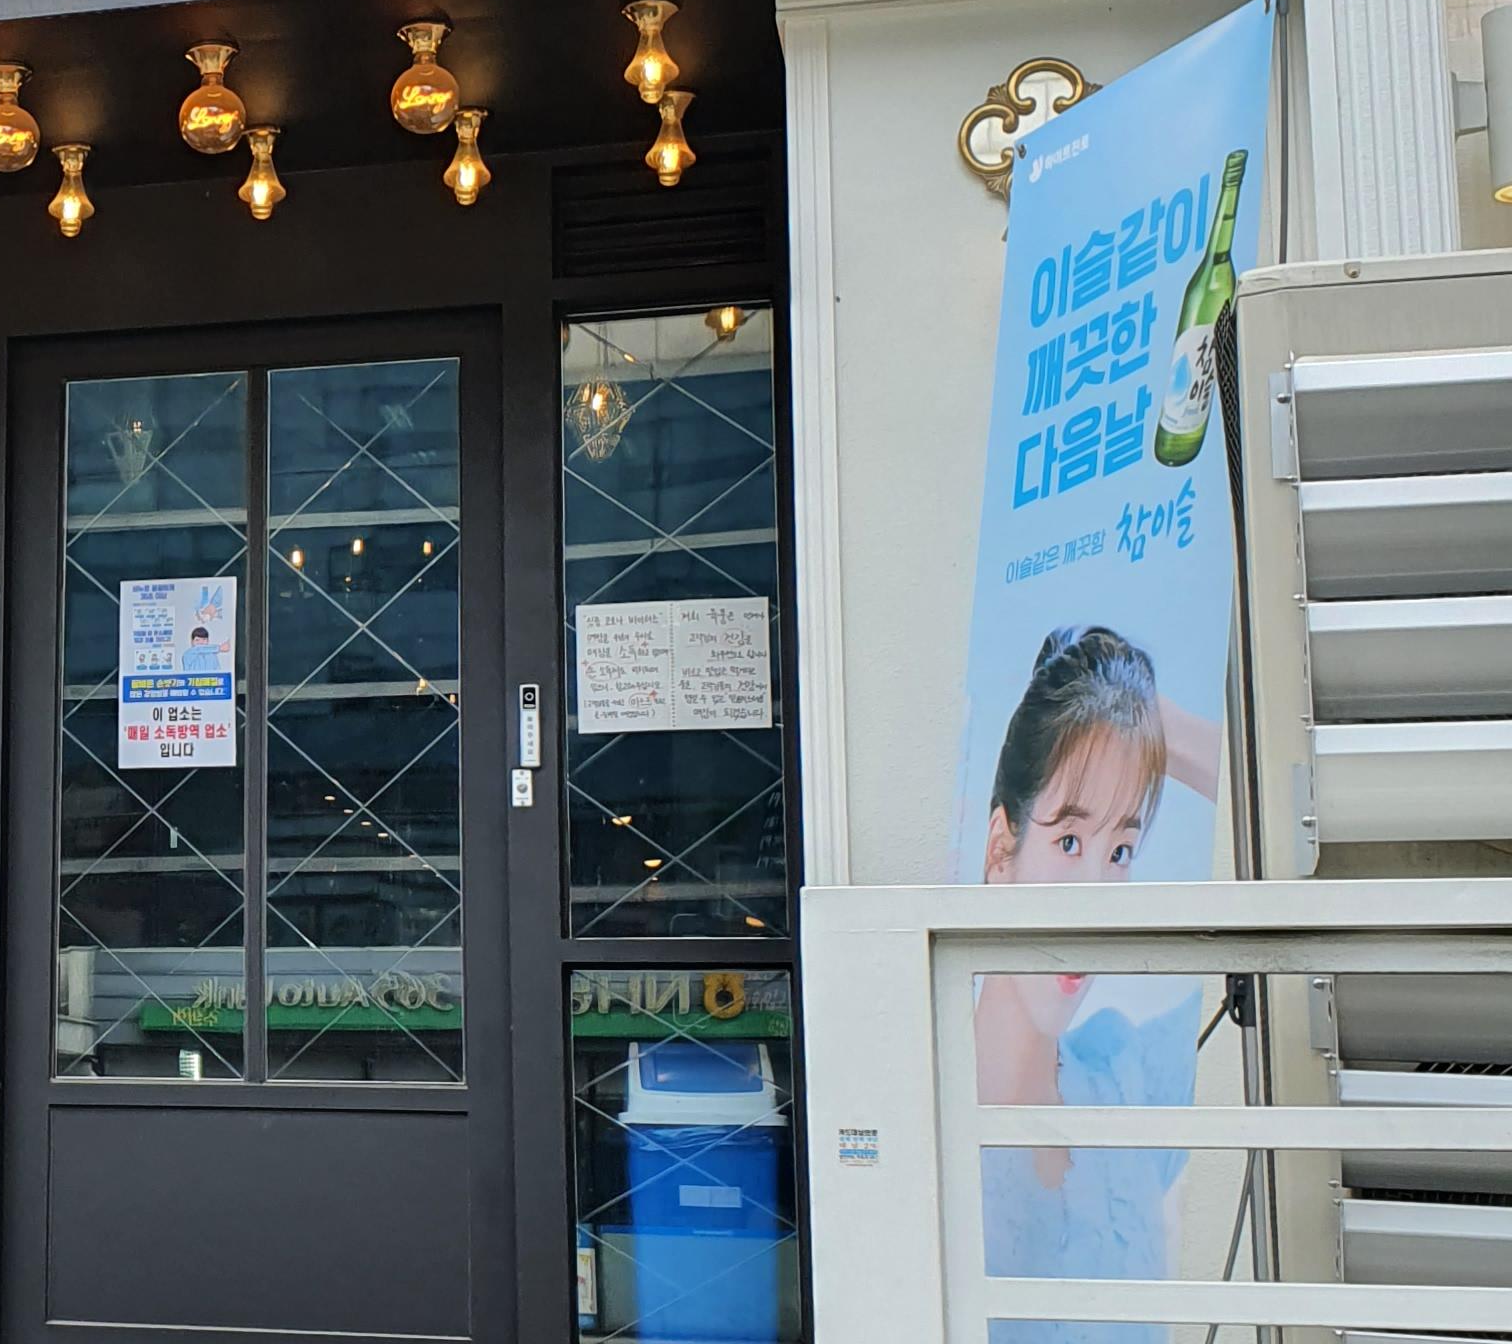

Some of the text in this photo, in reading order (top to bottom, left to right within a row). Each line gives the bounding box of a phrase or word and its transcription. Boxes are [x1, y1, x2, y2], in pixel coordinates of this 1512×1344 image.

[1029, 174, 1211, 330] 이슬같이
[1022, 291, 1158, 417] 깨끗한
[1013, 389, 1153, 510] 다음날
[1006, 544, 1060, 584] 이슬같은
[1115, 476, 1197, 563] 참이슬
[152, 706, 202, 722] 이 업소는
[154, 723, 201, 740] 소독방역
[160, 742, 195, 758] 입니다
